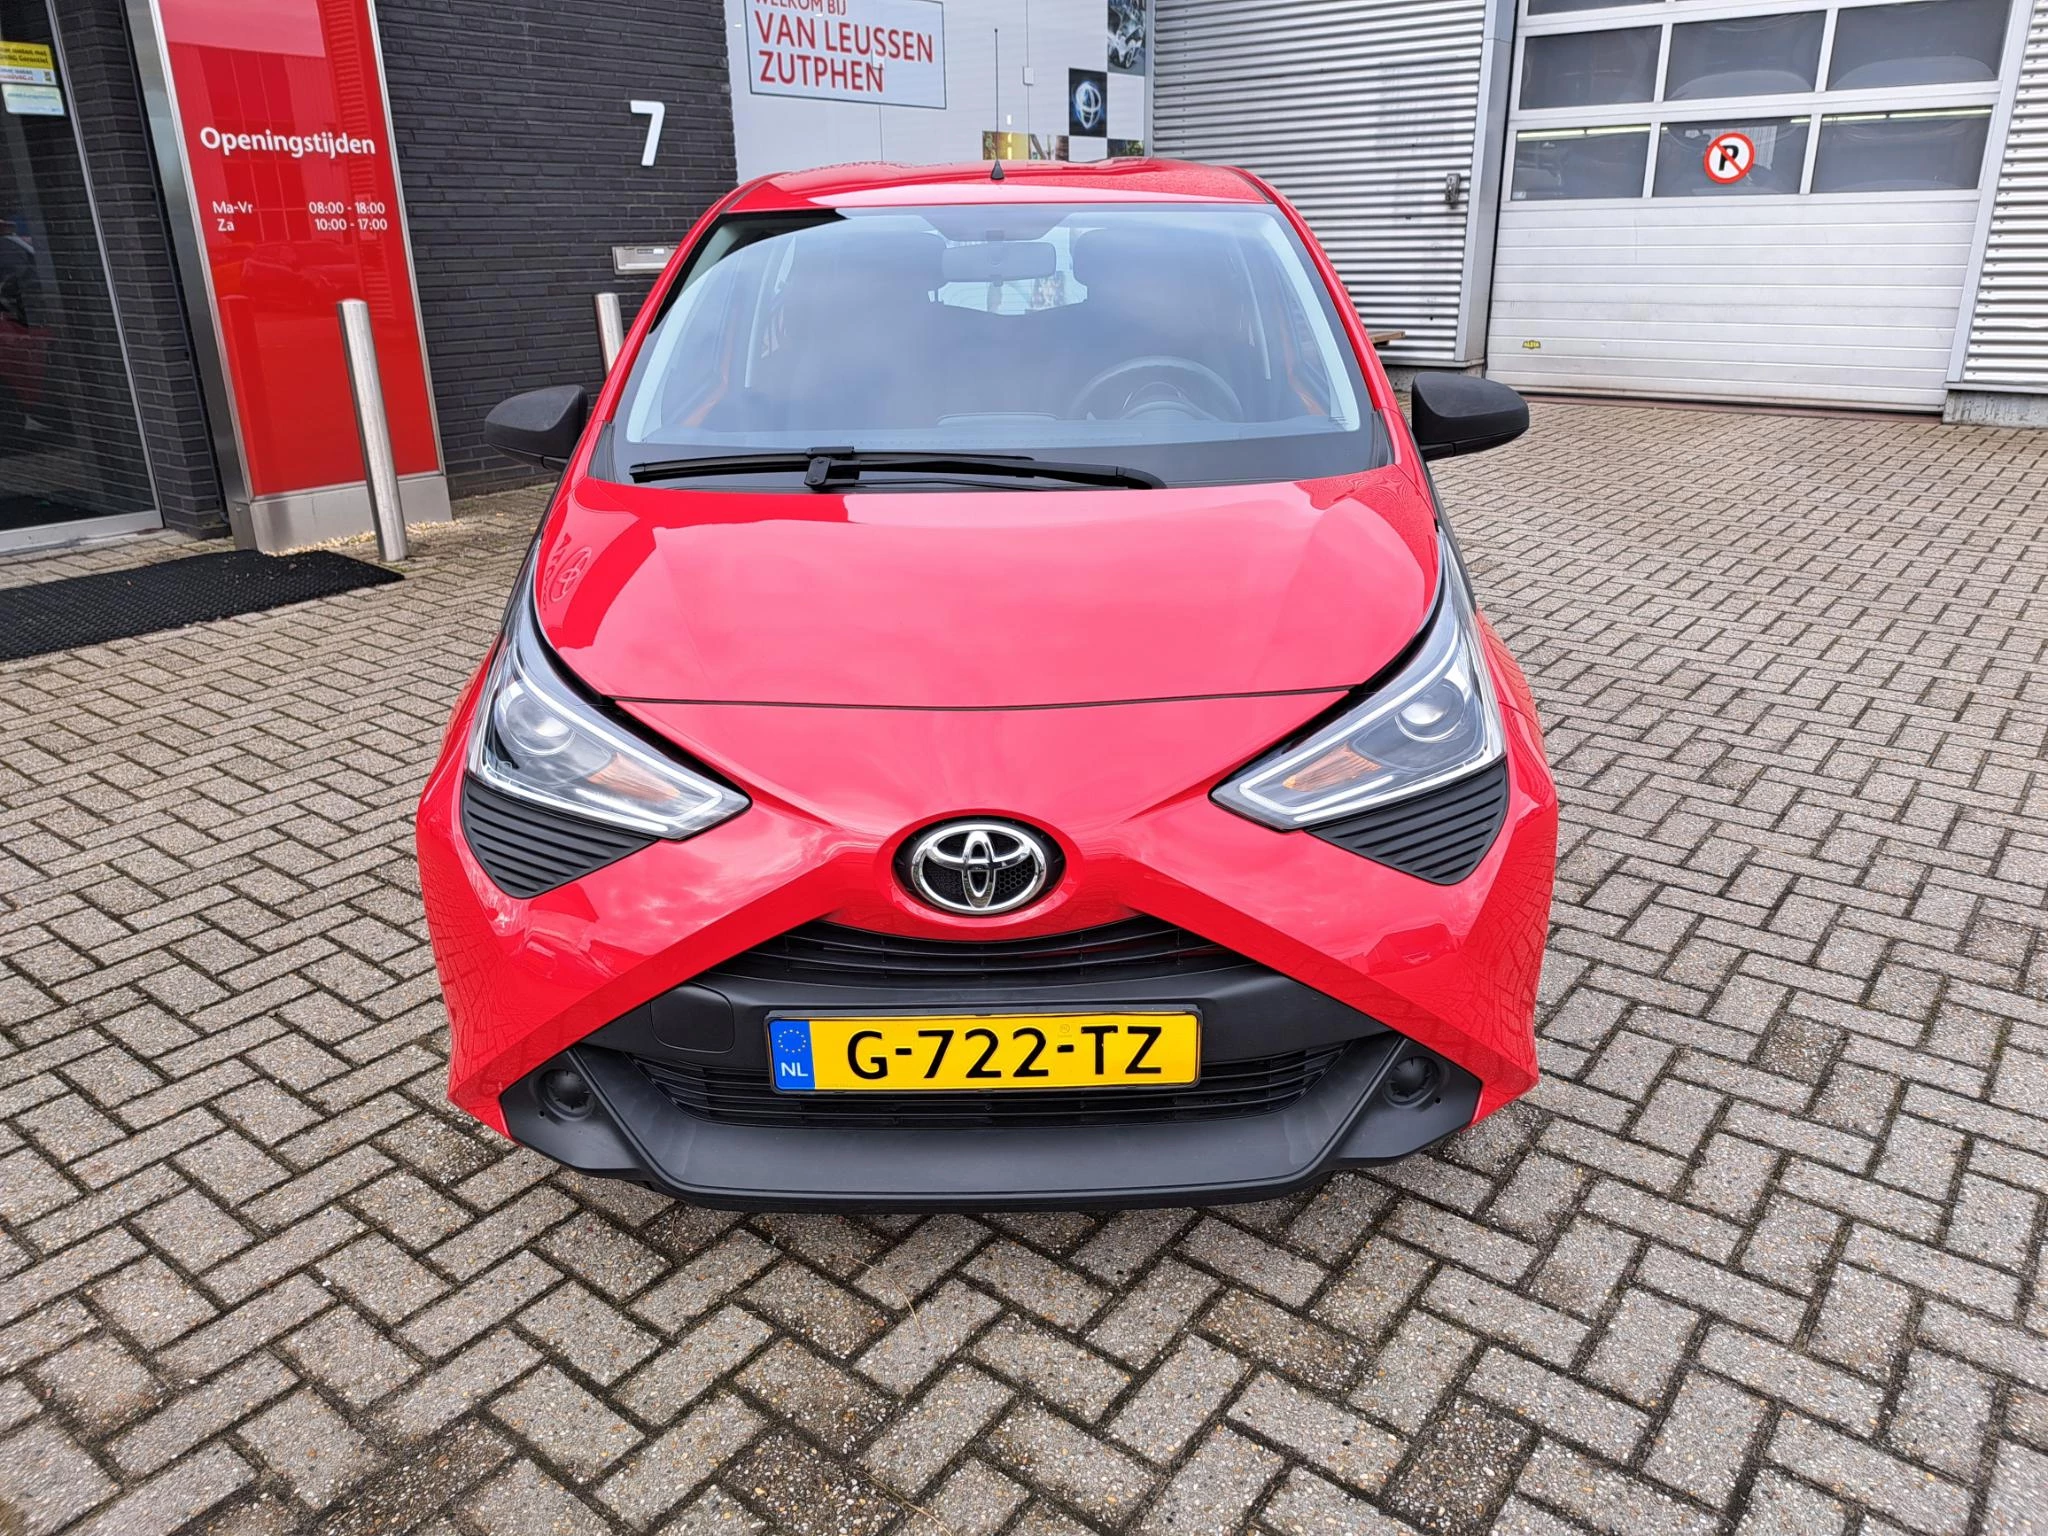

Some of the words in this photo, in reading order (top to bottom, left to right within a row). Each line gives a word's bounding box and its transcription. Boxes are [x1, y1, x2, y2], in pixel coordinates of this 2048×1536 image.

[756, 0, 823, 12] KOM
[828, 0, 846, 16] BIJ
[754, 11, 816, 49] VAN
[824, 20, 933, 63] LEUSSEN
[759, 50, 884, 93] ZUTPHEN
[200, 126, 376, 159] Openingstijden
[630, 100, 666, 167] 7
[1718, 144, 1740, 172] P
[212, 201, 254, 215] Ma-Vr
[308, 201, 344, 215] 08:00
[354, 201, 386, 215] 18:00
[217, 218, 235, 232] Za
[314, 218, 347, 231] 10:00
[357, 218, 388, 231] 17:00
[846, 1024, 1163, 1080] G-722-TZ
[780, 1061, 809, 1077] NL
